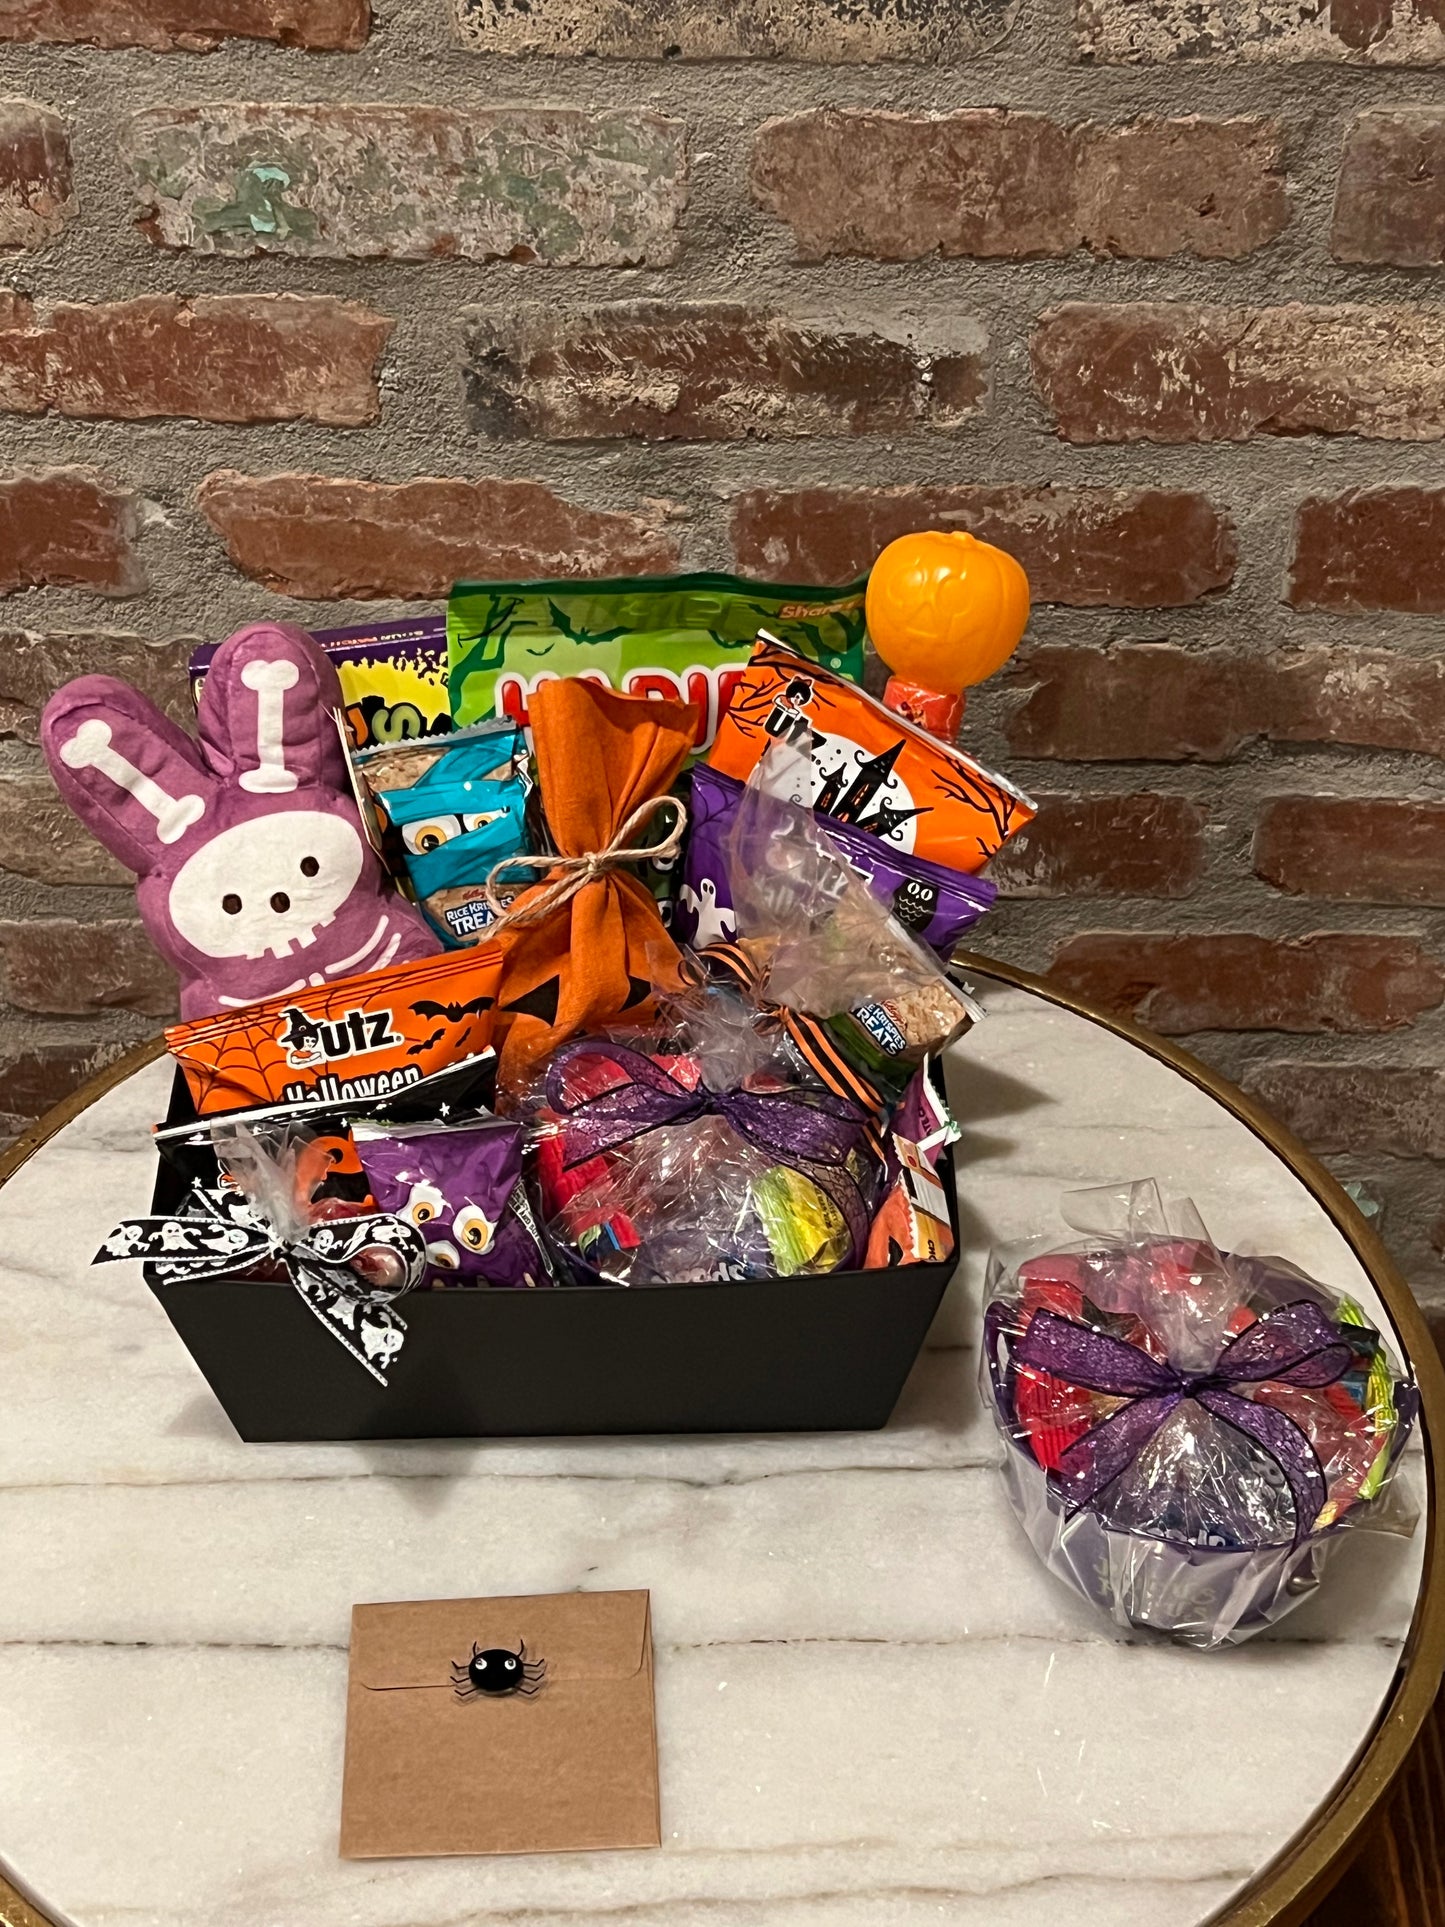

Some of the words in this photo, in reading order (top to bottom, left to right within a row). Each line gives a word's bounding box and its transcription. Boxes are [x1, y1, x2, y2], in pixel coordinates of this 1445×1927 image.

[446, 906, 470, 922] RICE
[451, 912, 495, 935] TREA
[856, 1007, 898, 1055] REATS
[286, 1067, 419, 1101] Halloween
